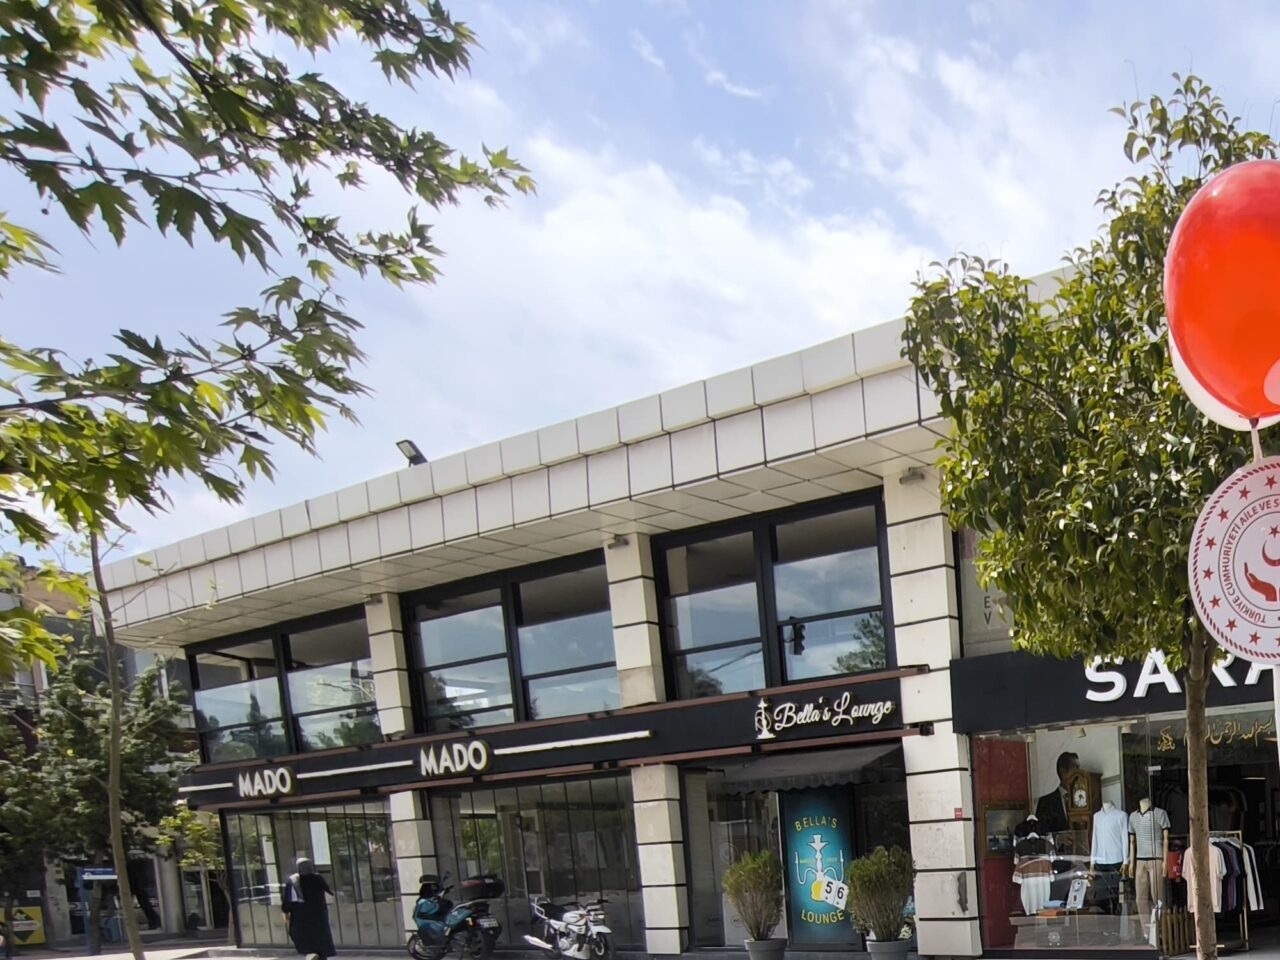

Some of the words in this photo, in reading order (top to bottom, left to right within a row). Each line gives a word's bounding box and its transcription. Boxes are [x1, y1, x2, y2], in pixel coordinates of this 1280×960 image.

[1240, 506, 1259, 525] AİLE
[1258, 501, 1272, 511] VE
[1222, 524, 1242, 595] CUMHURİYETİ
[1231, 593, 1266, 624] TÜRKİYE
[774, 696, 831, 731] Bella's
[831, 691, 893, 727] Lounge
[420, 741, 488, 777] MADO
[238, 767, 292, 798] MADO
[795, 815, 837, 832] BELLA'S
[801, 908, 845, 925] LOUNGE
